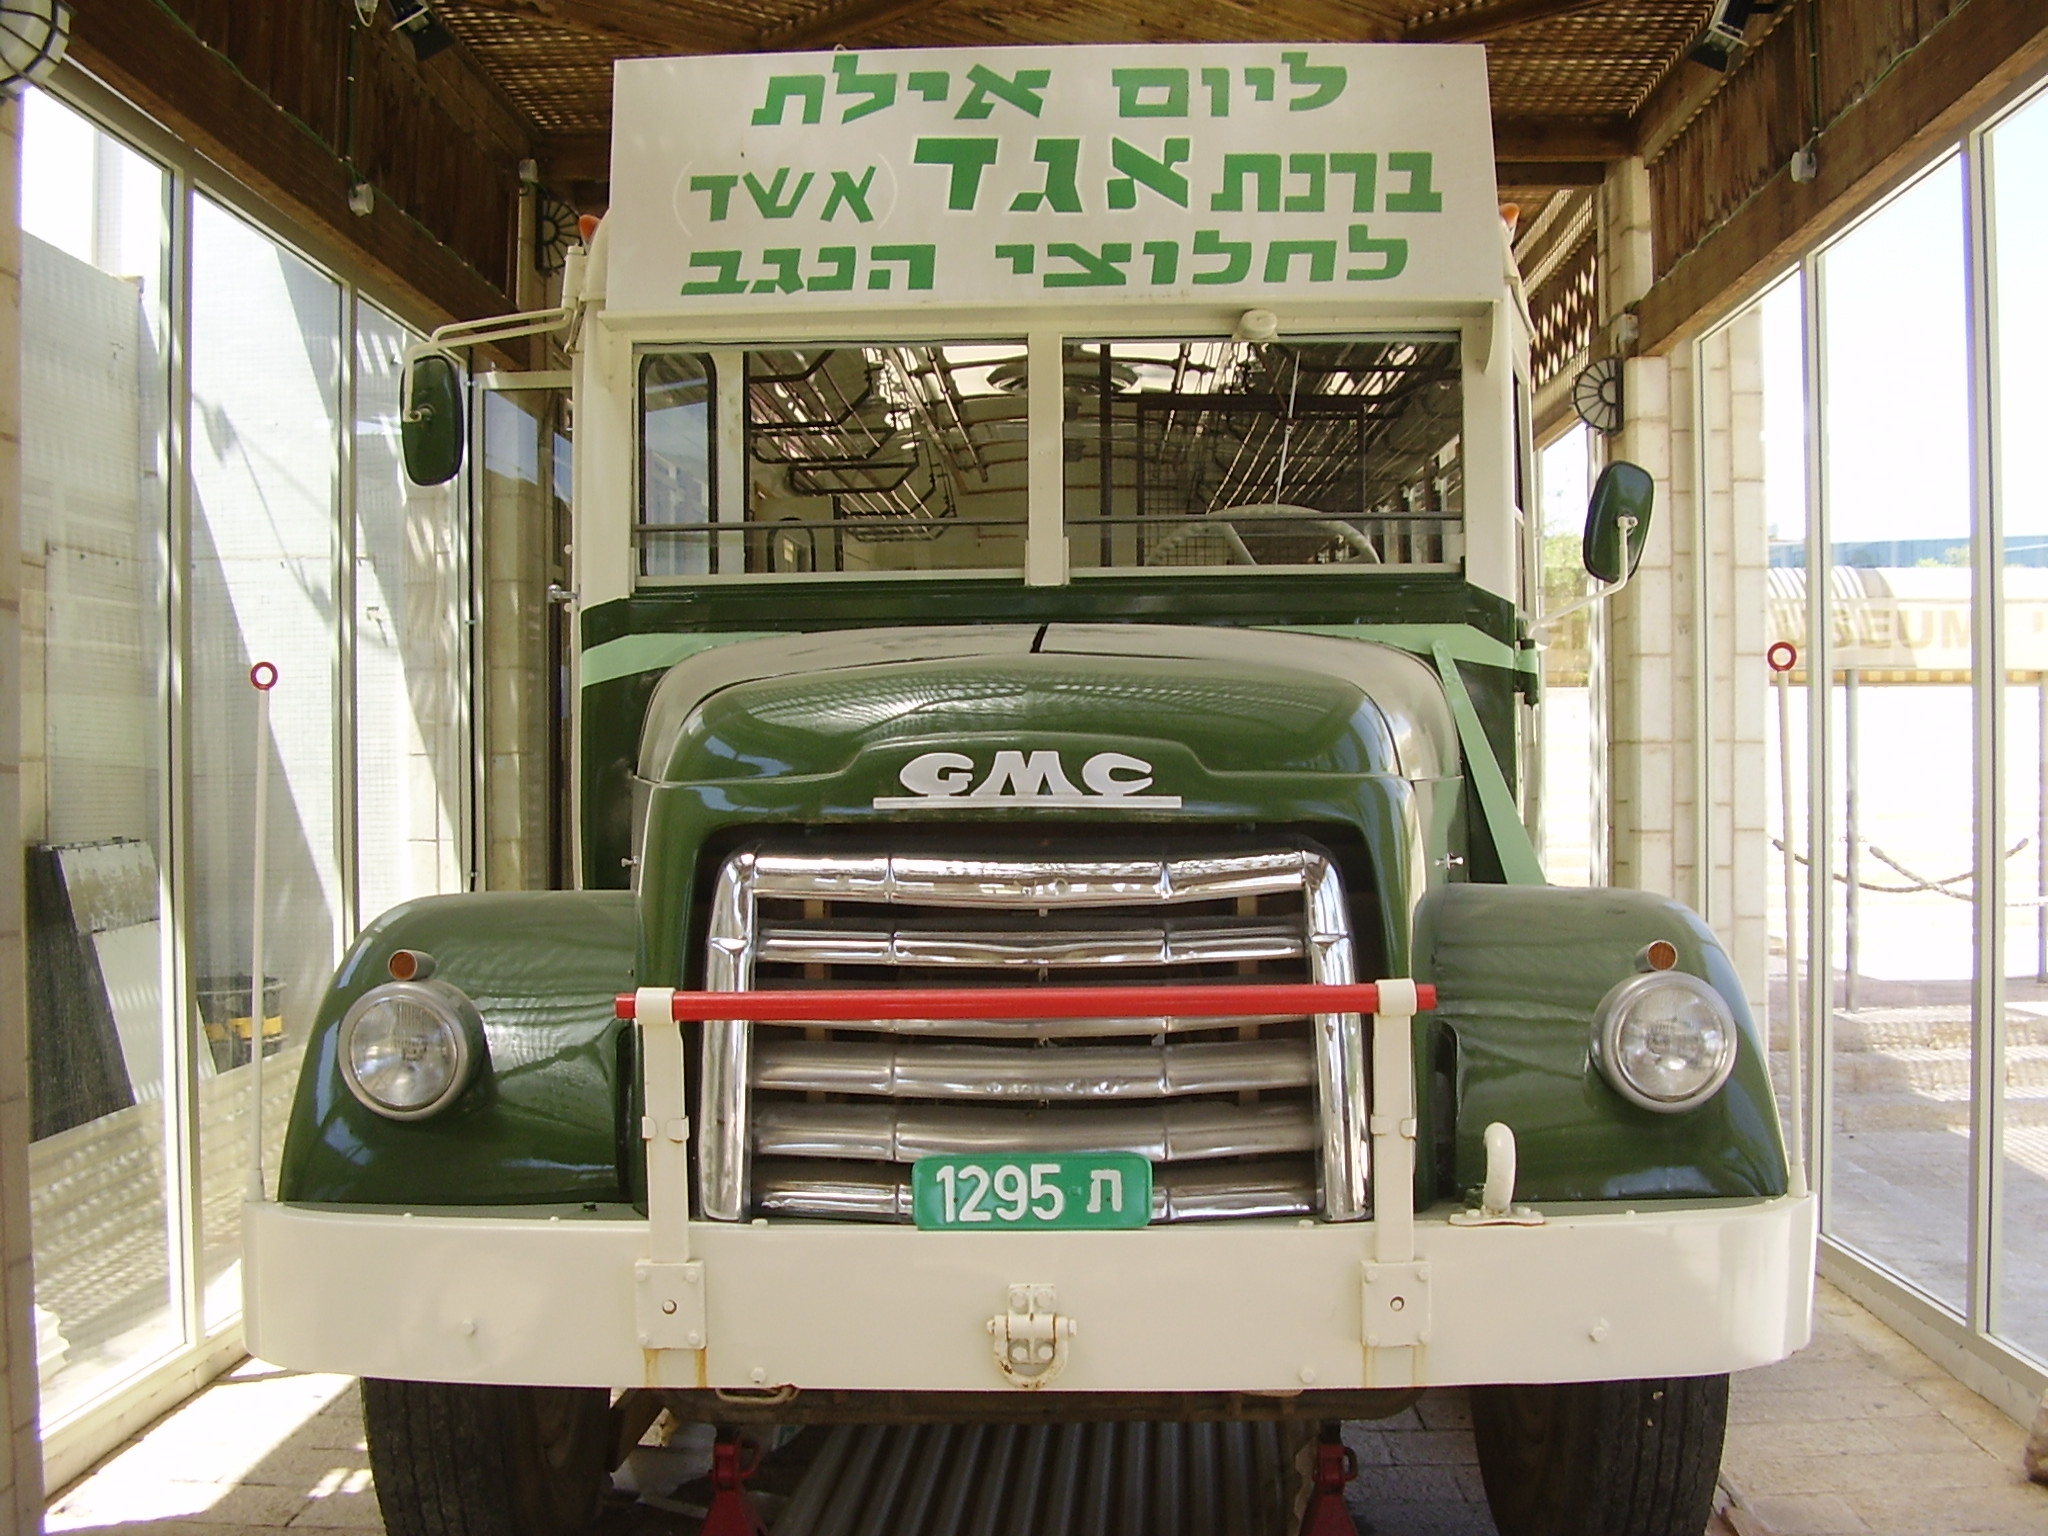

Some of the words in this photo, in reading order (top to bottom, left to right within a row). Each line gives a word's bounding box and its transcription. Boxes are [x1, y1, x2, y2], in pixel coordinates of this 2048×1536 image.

[750, 53, 1052, 126] אילת
[1111, 51, 1346, 119] ליום
[913, 137, 1190, 213] אגד
[680, 243, 937, 296] הנגב
[994, 223, 1409, 288] לחלוצי
[899, 750, 1153, 798] GMC
[935, 1163, 1066, 1223] 1295
[1086, 1168, 1124, 1214] ת
